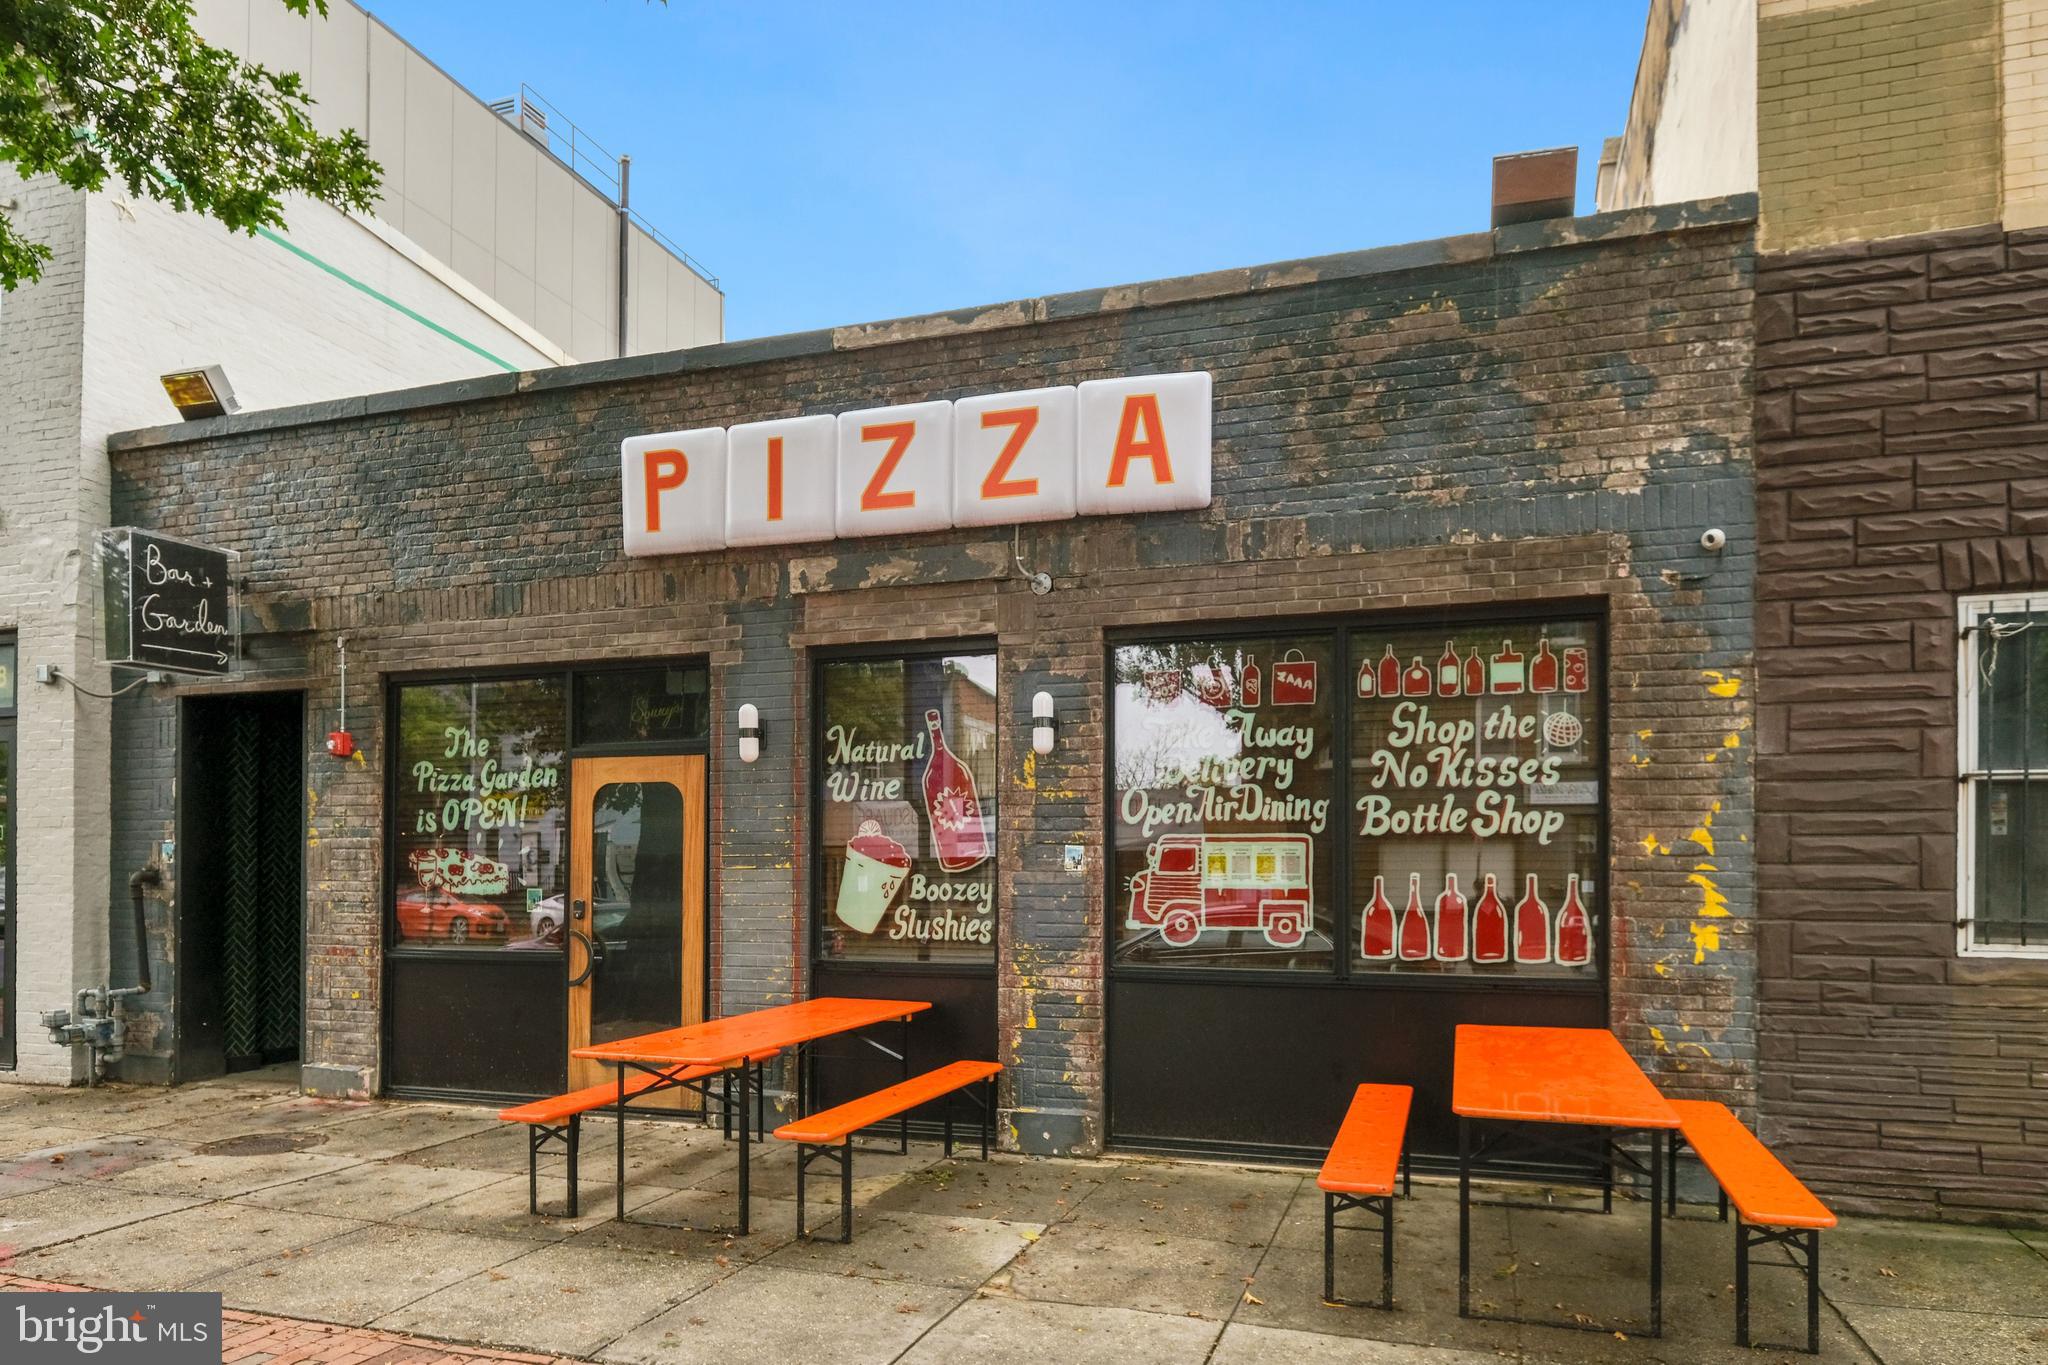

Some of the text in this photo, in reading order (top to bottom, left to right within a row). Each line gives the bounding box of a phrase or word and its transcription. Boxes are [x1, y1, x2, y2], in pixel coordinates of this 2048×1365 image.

[643, 392, 1175, 533] PIZZA
[146, 543, 196, 587] Bar
[141, 593, 228, 635] Garden
[444, 726, 489, 758] The
[826, 725, 925, 765] Natural
[1225, 708, 1314, 759] Away
[1387, 701, 1536, 753] Shop the
[412, 756, 558, 797] Pizza Garden
[826, 771, 900, 802] Wine
[1370, 746, 1562, 788] No Kisses
[416, 794, 528, 833] is OPEN!
[1121, 783, 1330, 837] Open Air Dining
[1355, 790, 1564, 845] Bottle Shop
[909, 873, 992, 914] Boozey
[889, 905, 992, 944] Slushies
